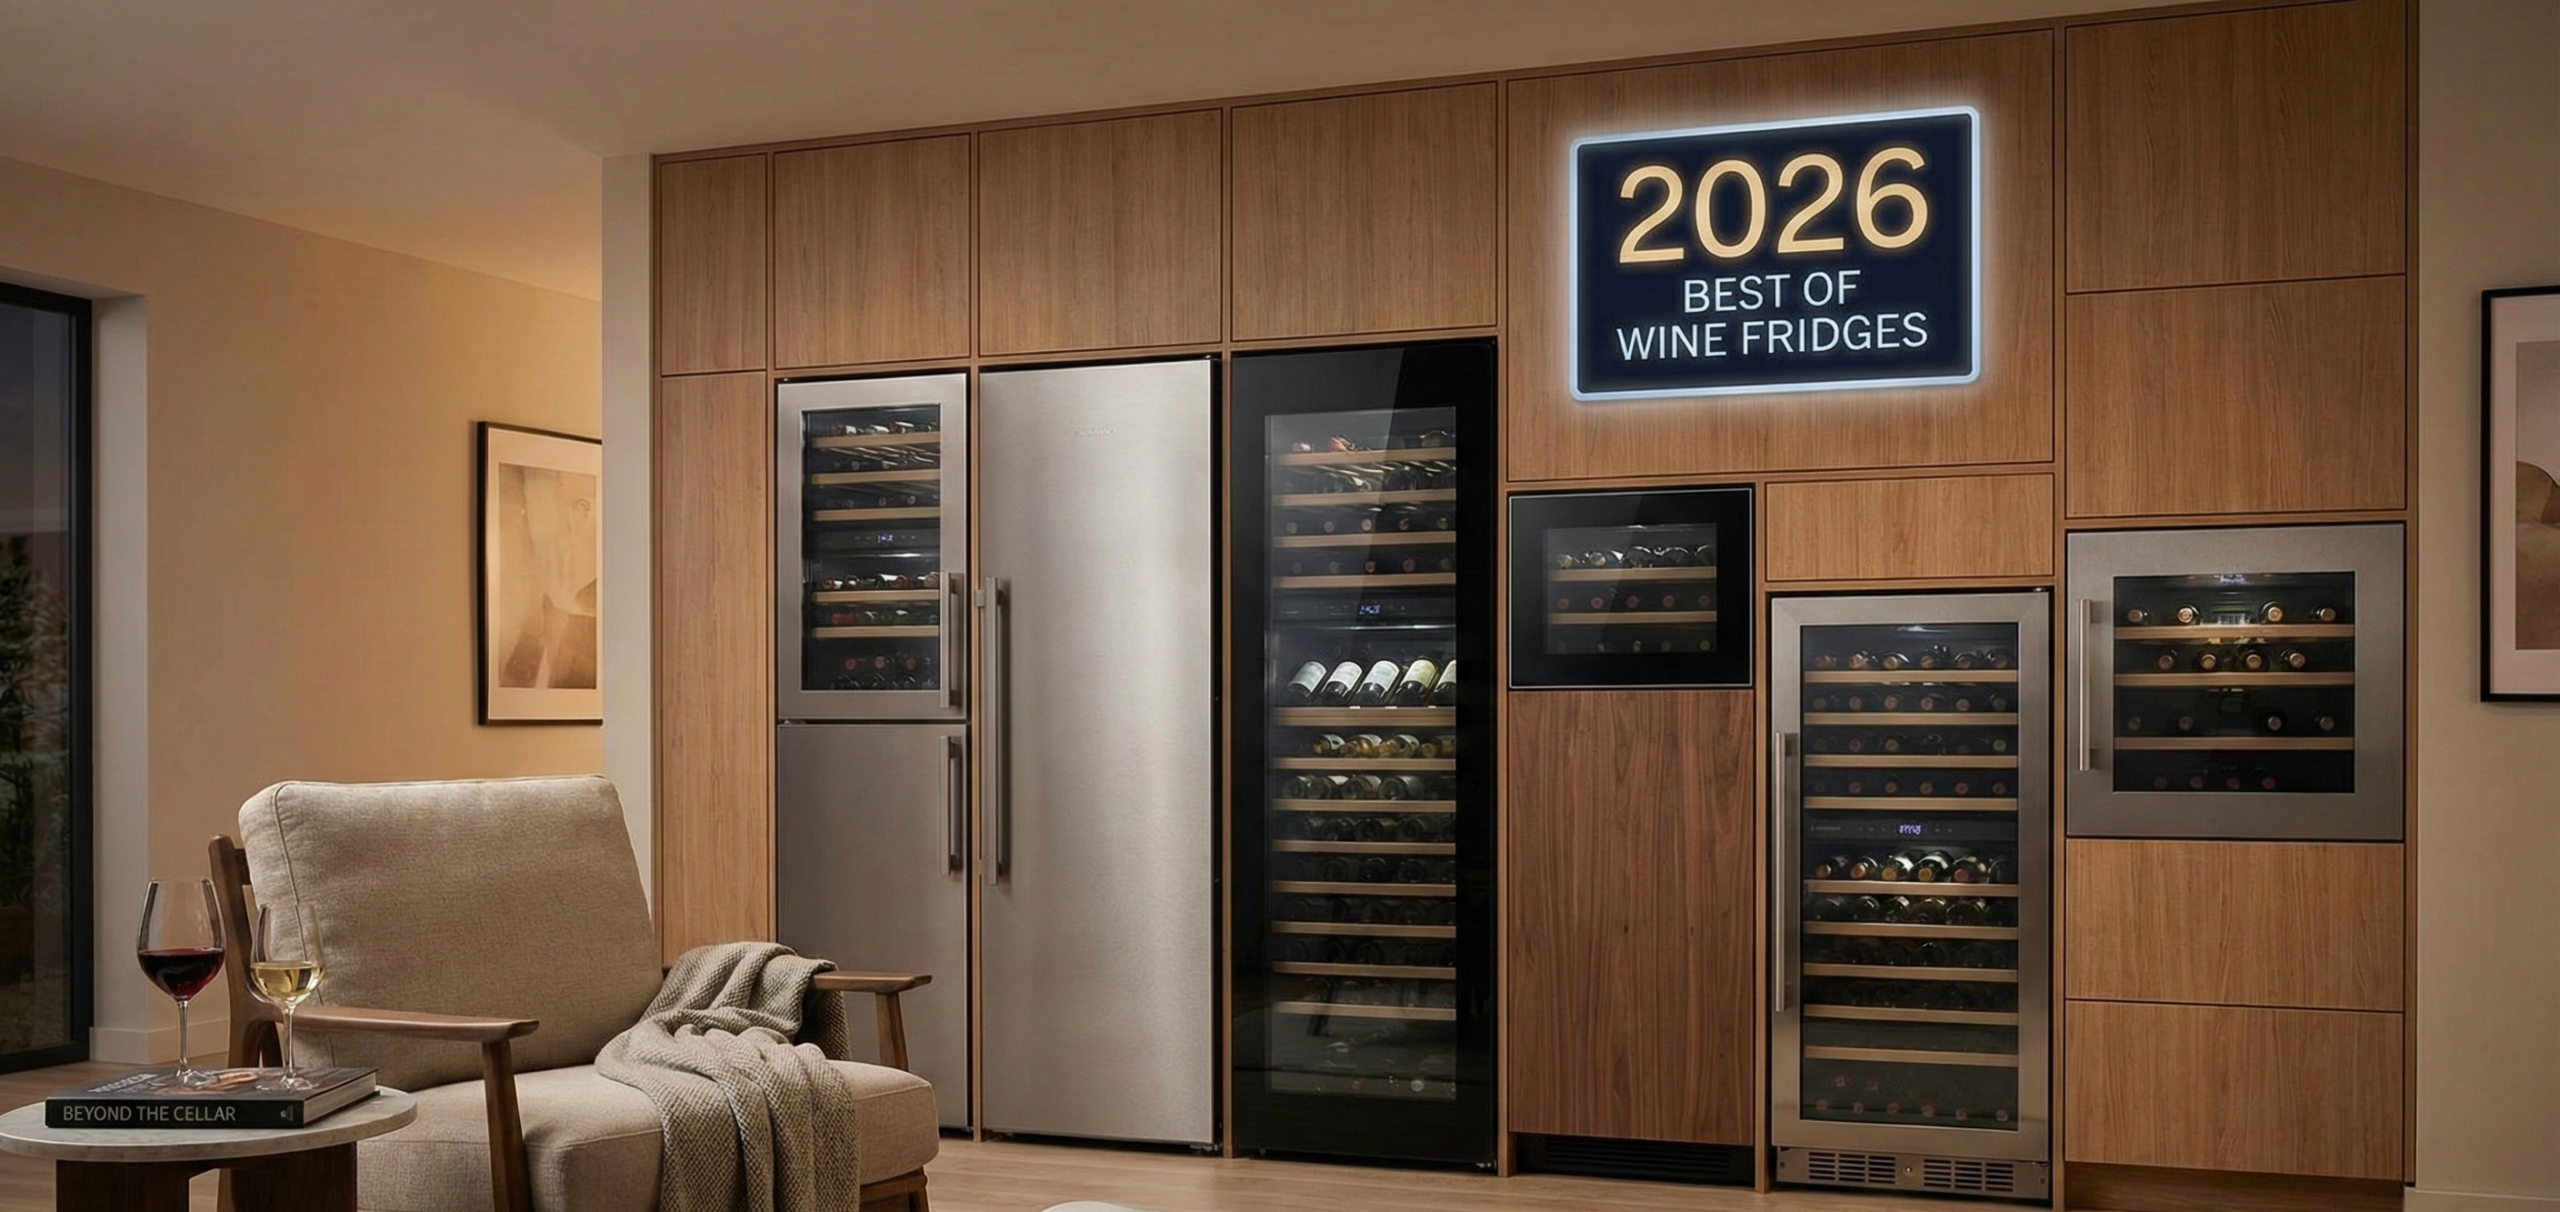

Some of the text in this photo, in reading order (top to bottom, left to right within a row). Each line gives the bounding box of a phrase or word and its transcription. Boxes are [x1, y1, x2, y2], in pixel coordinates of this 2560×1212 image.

[1618, 147, 1928, 264] 2026
[1684, 269, 1861, 313] BEST OF
[1616, 311, 1929, 361] WINE FRIDGES
[63, 1105, 236, 1121] BEYOND THE CELLAR
